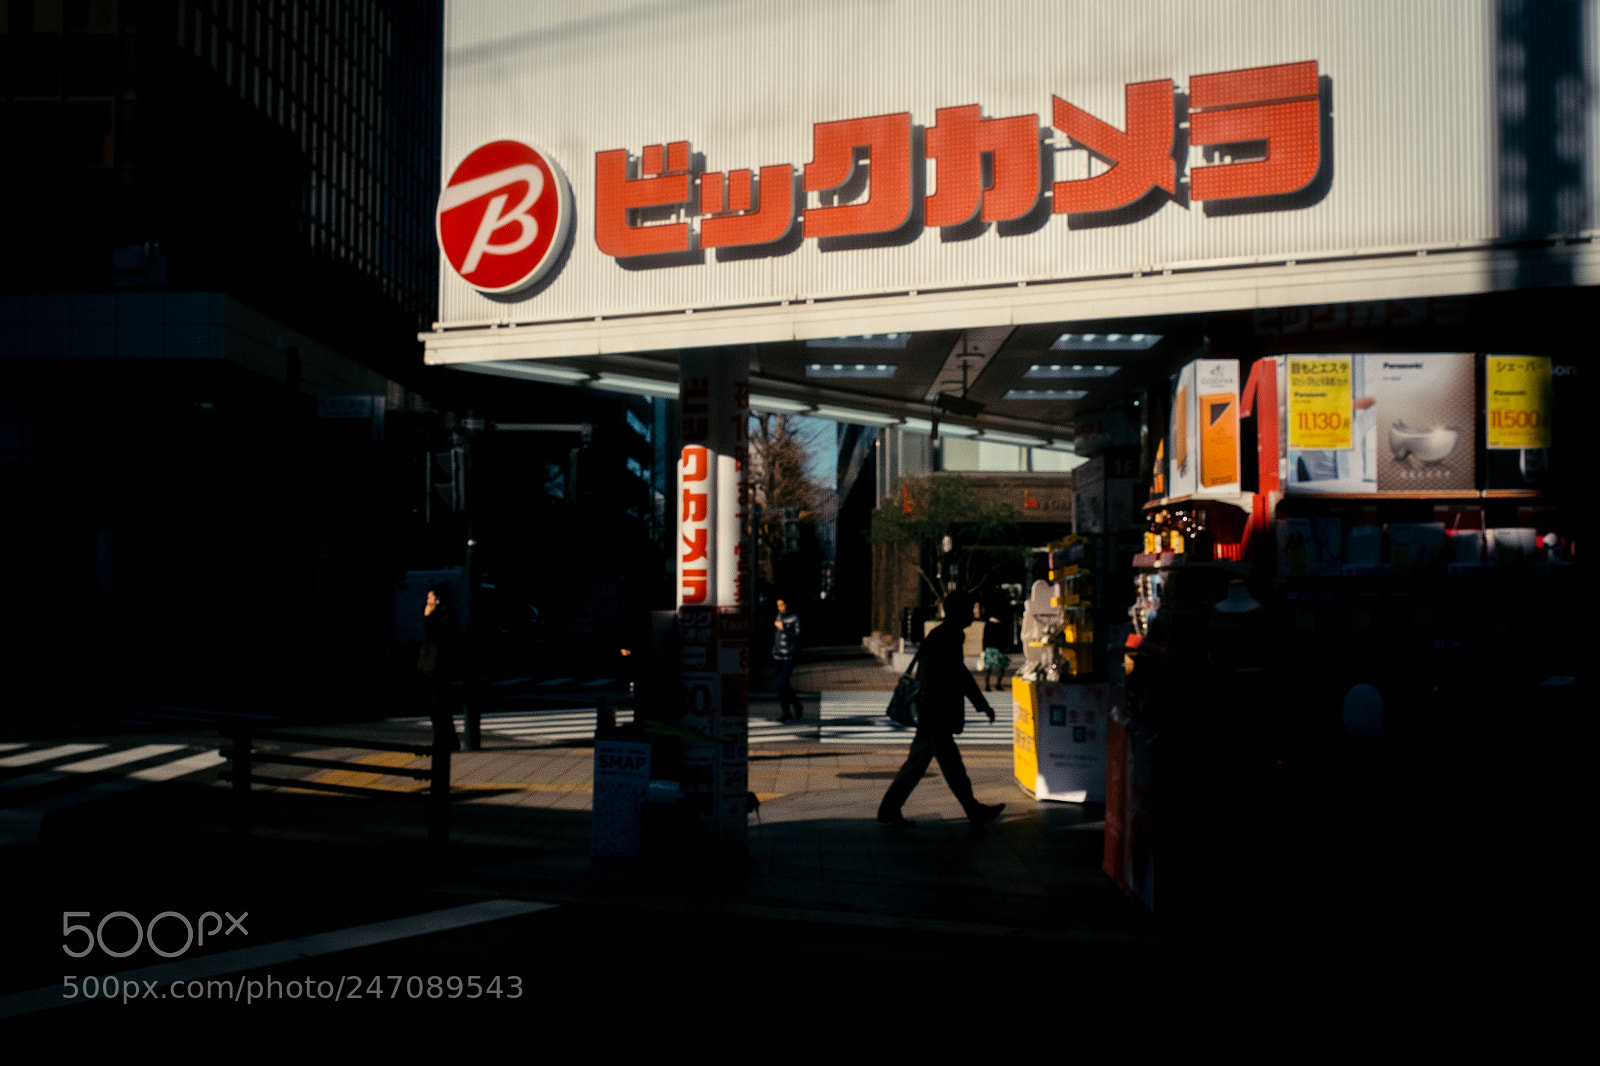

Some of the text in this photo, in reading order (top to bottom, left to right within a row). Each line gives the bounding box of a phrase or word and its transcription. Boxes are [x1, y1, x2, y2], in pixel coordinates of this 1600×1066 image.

[595, 60, 1320, 256] ビックカメラ
[1291, 363, 1348, 379] 目もとエステ
[1496, 361, 1545, 372] シェーバー
[682, 378, 709, 603] ビックカメラ
[598, 754, 647, 770] SMAP
